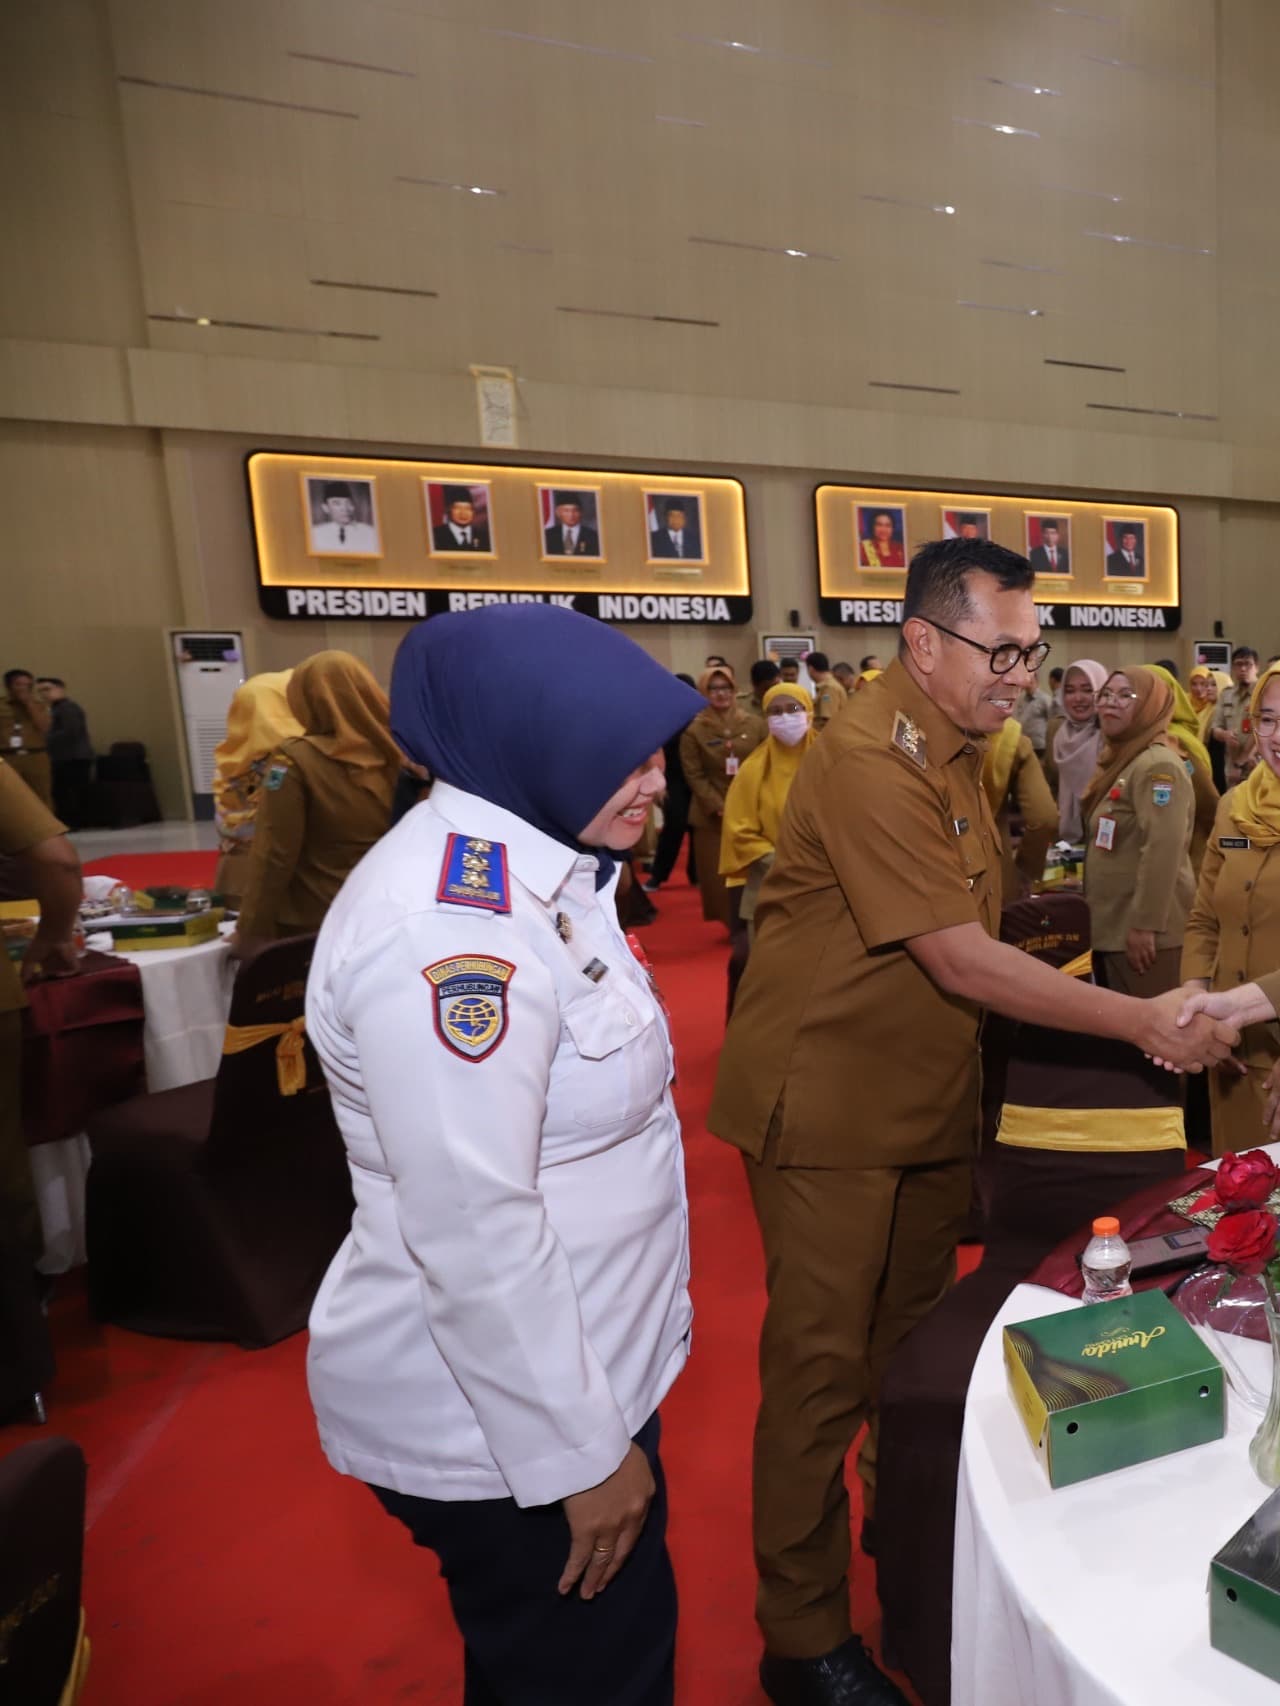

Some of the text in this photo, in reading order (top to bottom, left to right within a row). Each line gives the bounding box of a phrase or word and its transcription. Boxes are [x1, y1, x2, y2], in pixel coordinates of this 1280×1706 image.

[286, 589, 427, 617] PRESIDEN
[598, 595, 730, 621] INDONESIA
[1070, 606, 1166, 628] INDONESIA
[1081, 1326, 1165, 1358] Annida
